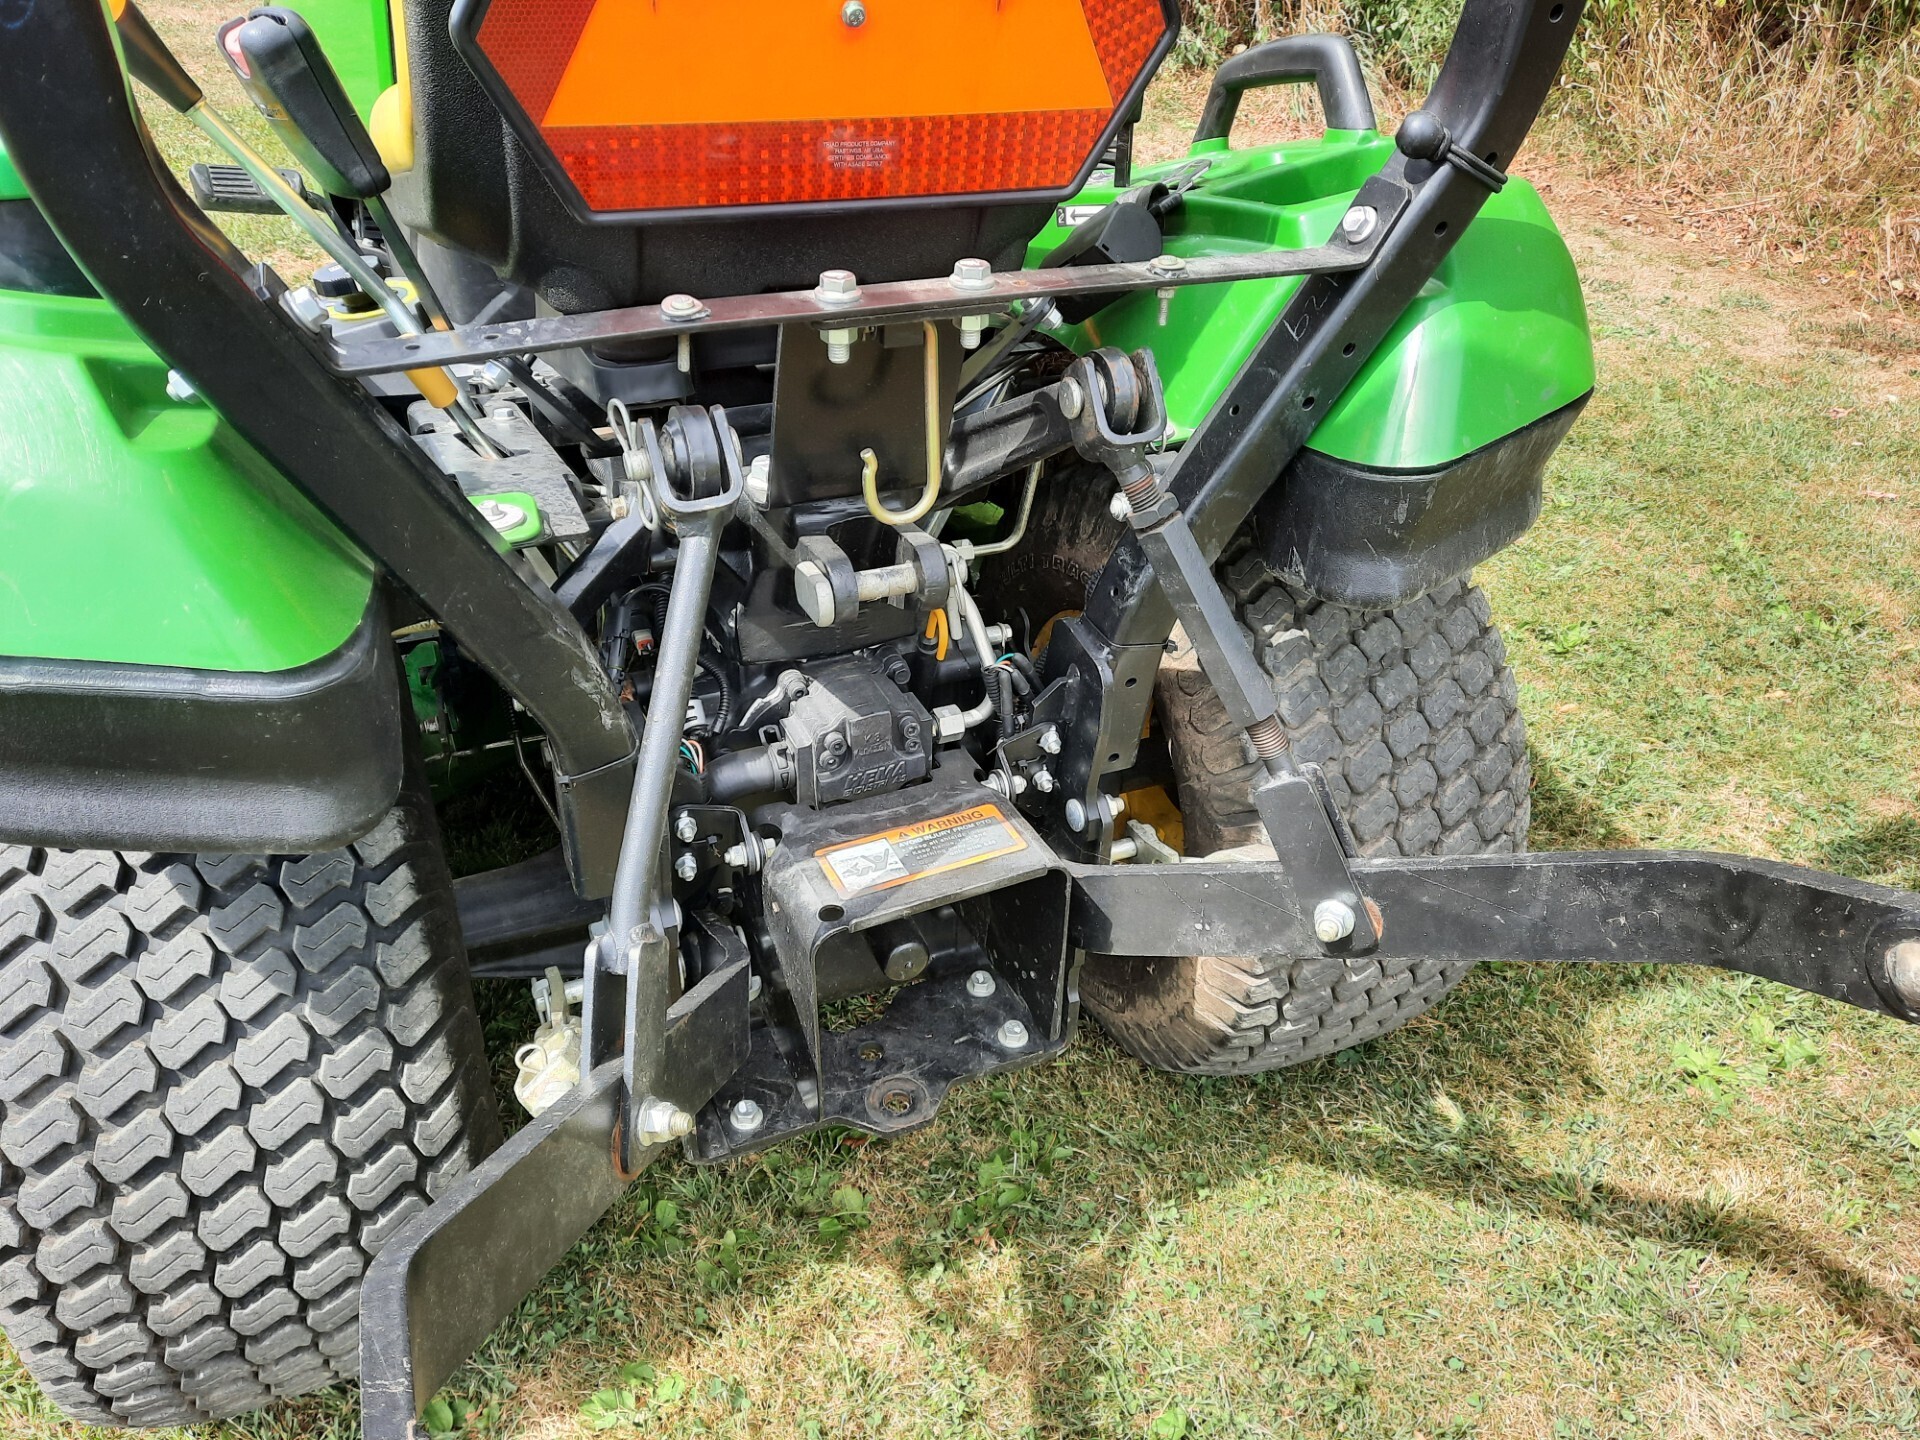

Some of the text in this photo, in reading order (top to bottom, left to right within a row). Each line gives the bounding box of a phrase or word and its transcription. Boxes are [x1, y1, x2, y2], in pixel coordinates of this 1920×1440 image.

[911, 810, 984, 835] WARNING
[898, 836, 923, 848] AVOID
[924, 829, 952, 841] INJURY
[953, 823, 976, 833] FROM
[975, 819, 992, 827] PTO
[909, 842, 928, 852] Keep
[911, 846, 931, 856] Keep
